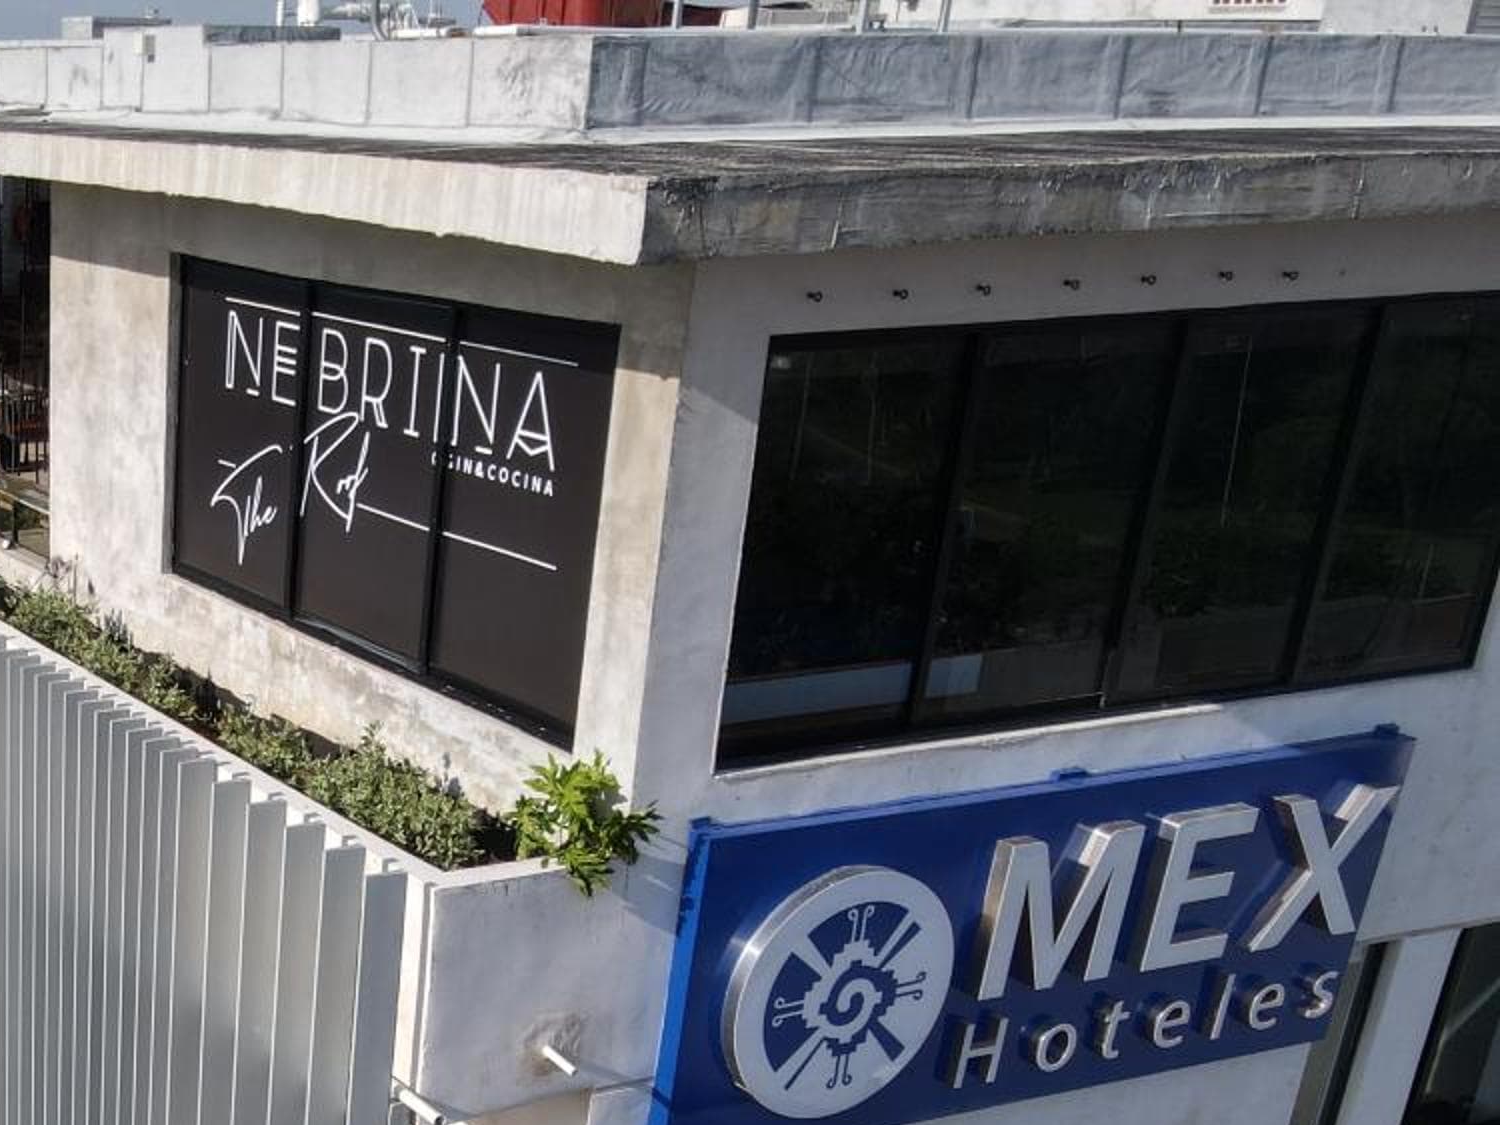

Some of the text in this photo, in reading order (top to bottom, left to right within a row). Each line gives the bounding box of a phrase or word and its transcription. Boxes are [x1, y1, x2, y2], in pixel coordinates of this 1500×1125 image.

[210, 444, 293, 566] The
[976, 782, 1401, 1001] MEX
[948, 968, 1341, 1090] Hoteles
